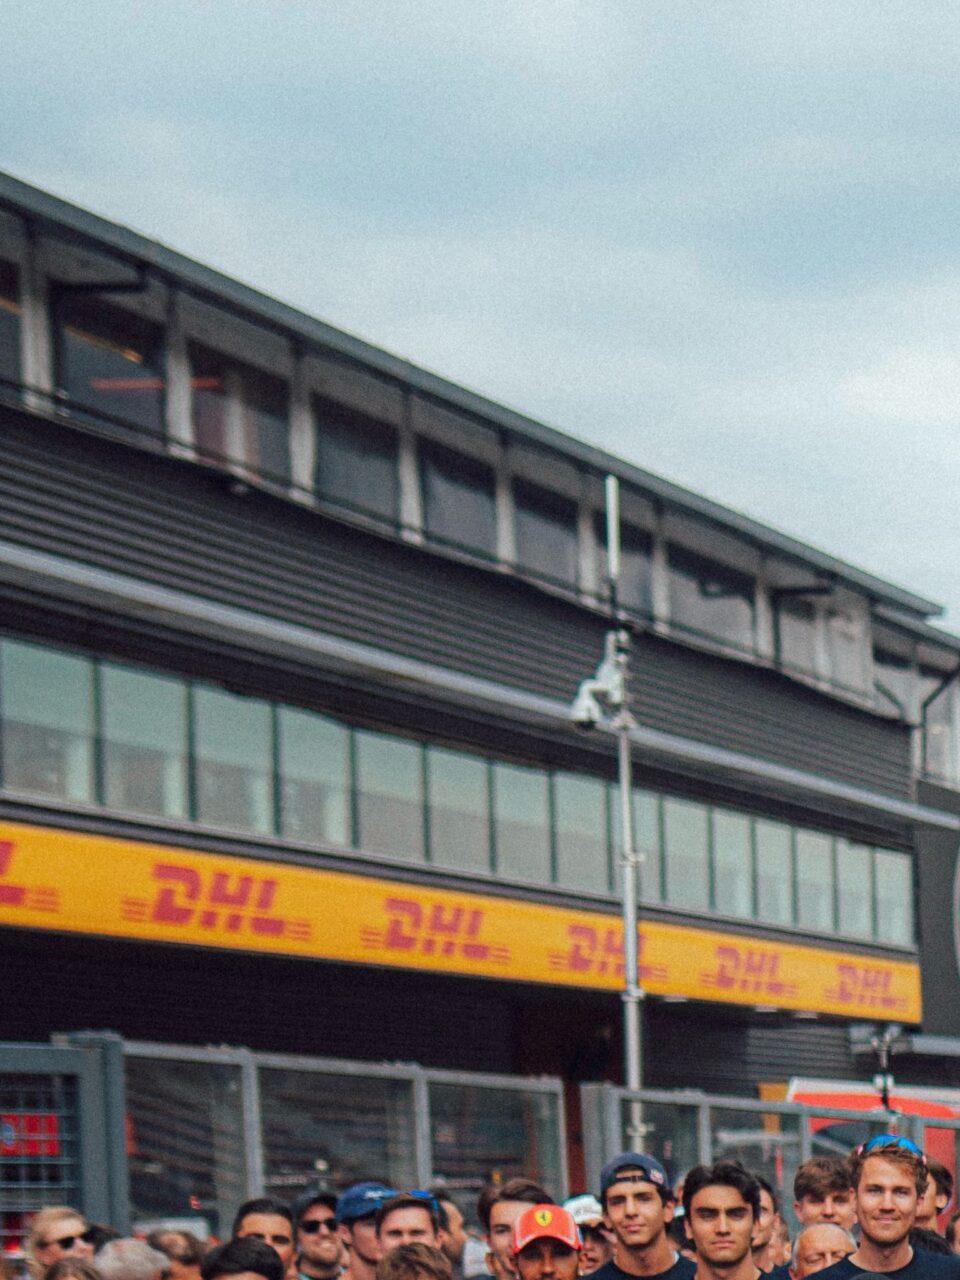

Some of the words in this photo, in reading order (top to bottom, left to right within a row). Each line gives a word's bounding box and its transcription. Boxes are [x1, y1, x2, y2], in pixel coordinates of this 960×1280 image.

[151, 863, 286, 935] DHL
[384, 897, 489, 960] DHL
[567, 923, 652, 979] DHL
[714, 945, 785, 995] DHL
[836, 964, 897, 1008] DHL
